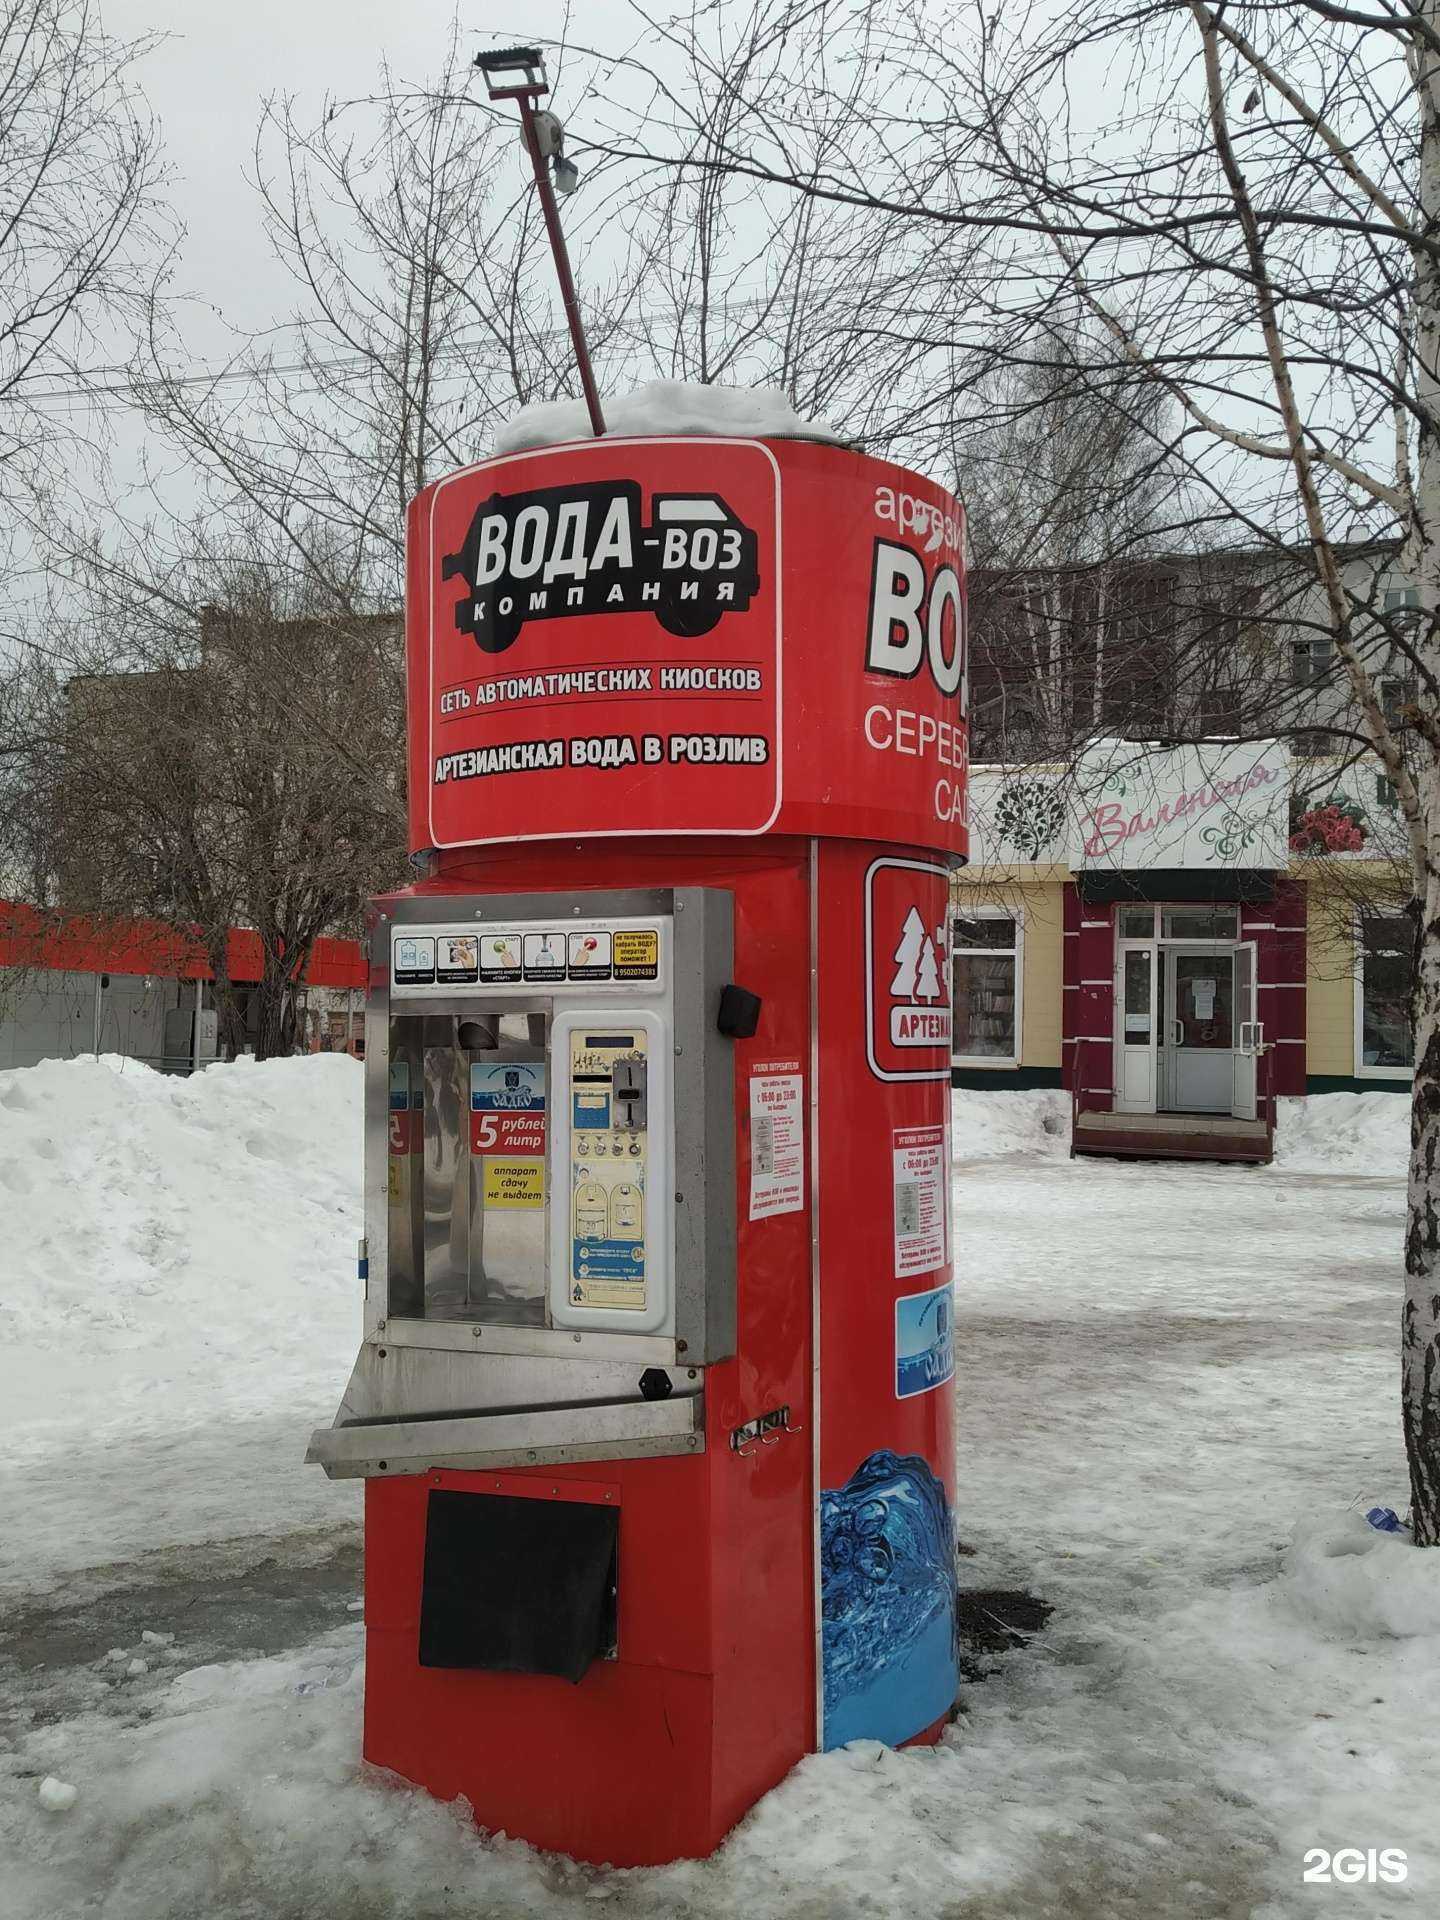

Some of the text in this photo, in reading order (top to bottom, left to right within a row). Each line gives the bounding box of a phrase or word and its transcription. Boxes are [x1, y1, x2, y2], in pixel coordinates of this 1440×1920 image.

[476, 496, 742, 586] ВОДА-ВОЗ
[473, 581, 735, 621] КОМПАНИЯ
[440, 668, 762, 714] СЕТЬ АВТОМАТИЧЕСКИХ КИОСКОВ
[434, 736, 768, 783] АРТЕЗИАНСКАЯ ВОДА В РОЗЛИВ
[476, 1115, 499, 1148] 5
[504, 1135, 541, 1148] литр
[493, 1167, 538, 1177] аппарат
[501, 1178, 528, 1189] сдачу
[487, 1189, 542, 1200] не выдает
